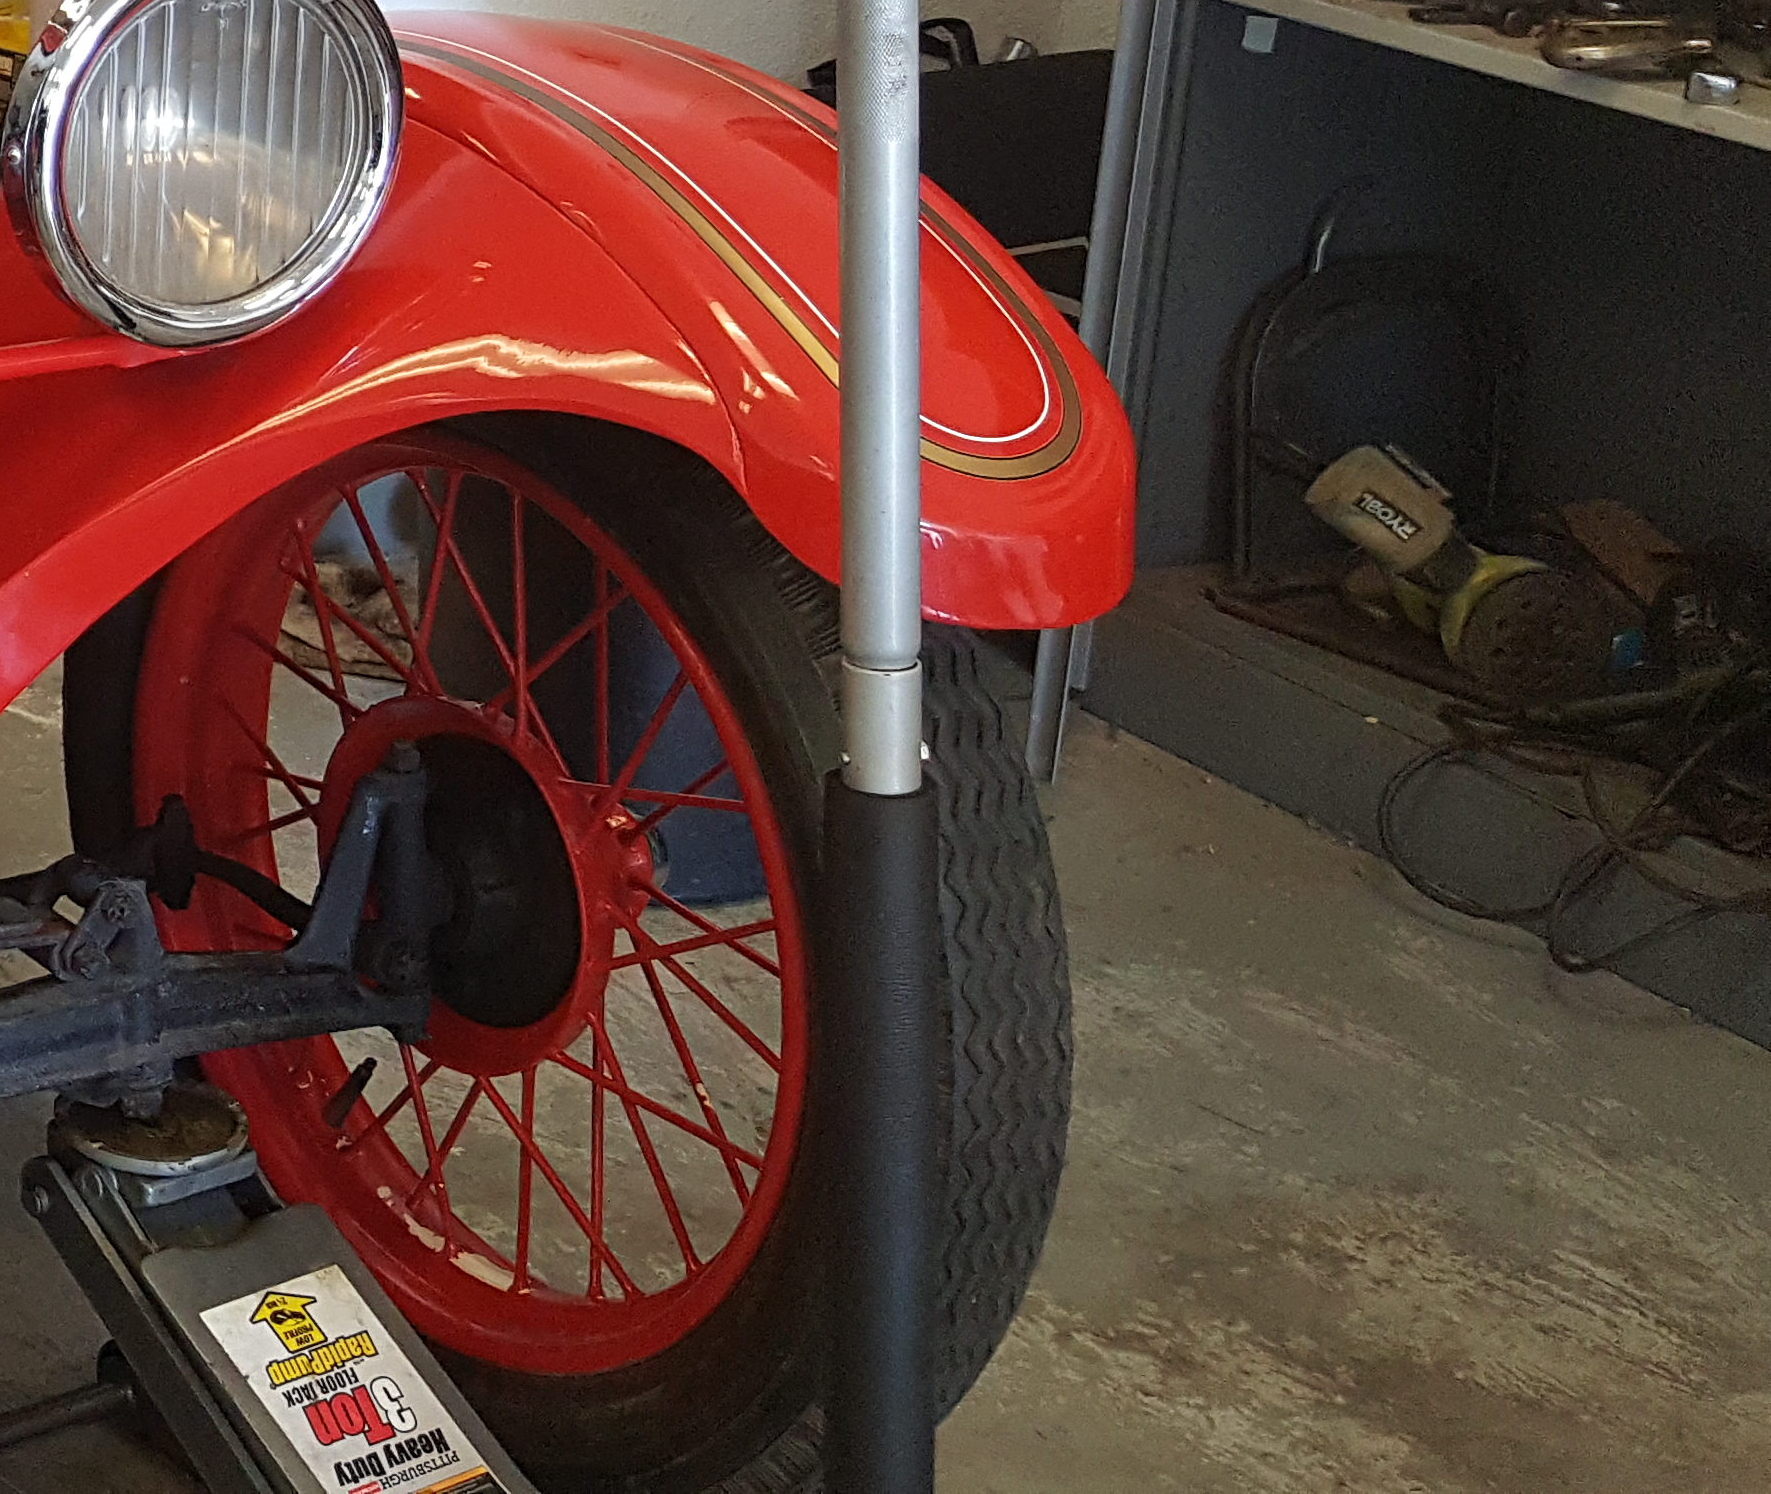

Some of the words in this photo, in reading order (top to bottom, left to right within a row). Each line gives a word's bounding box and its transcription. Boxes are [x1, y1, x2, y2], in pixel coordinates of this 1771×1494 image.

[1359, 491, 1418, 540] RYOBI
[281, 1379, 317, 1408] JACK
[317, 1366, 360, 1396] FLOOR
[303, 1383, 397, 1447] Ton
[369, 1375, 418, 1434] 3
[382, 1426, 451, 1469] Heavy
[333, 1451, 387, 1487] Duty
[378, 1450, 461, 1491] PITTSBURGH
